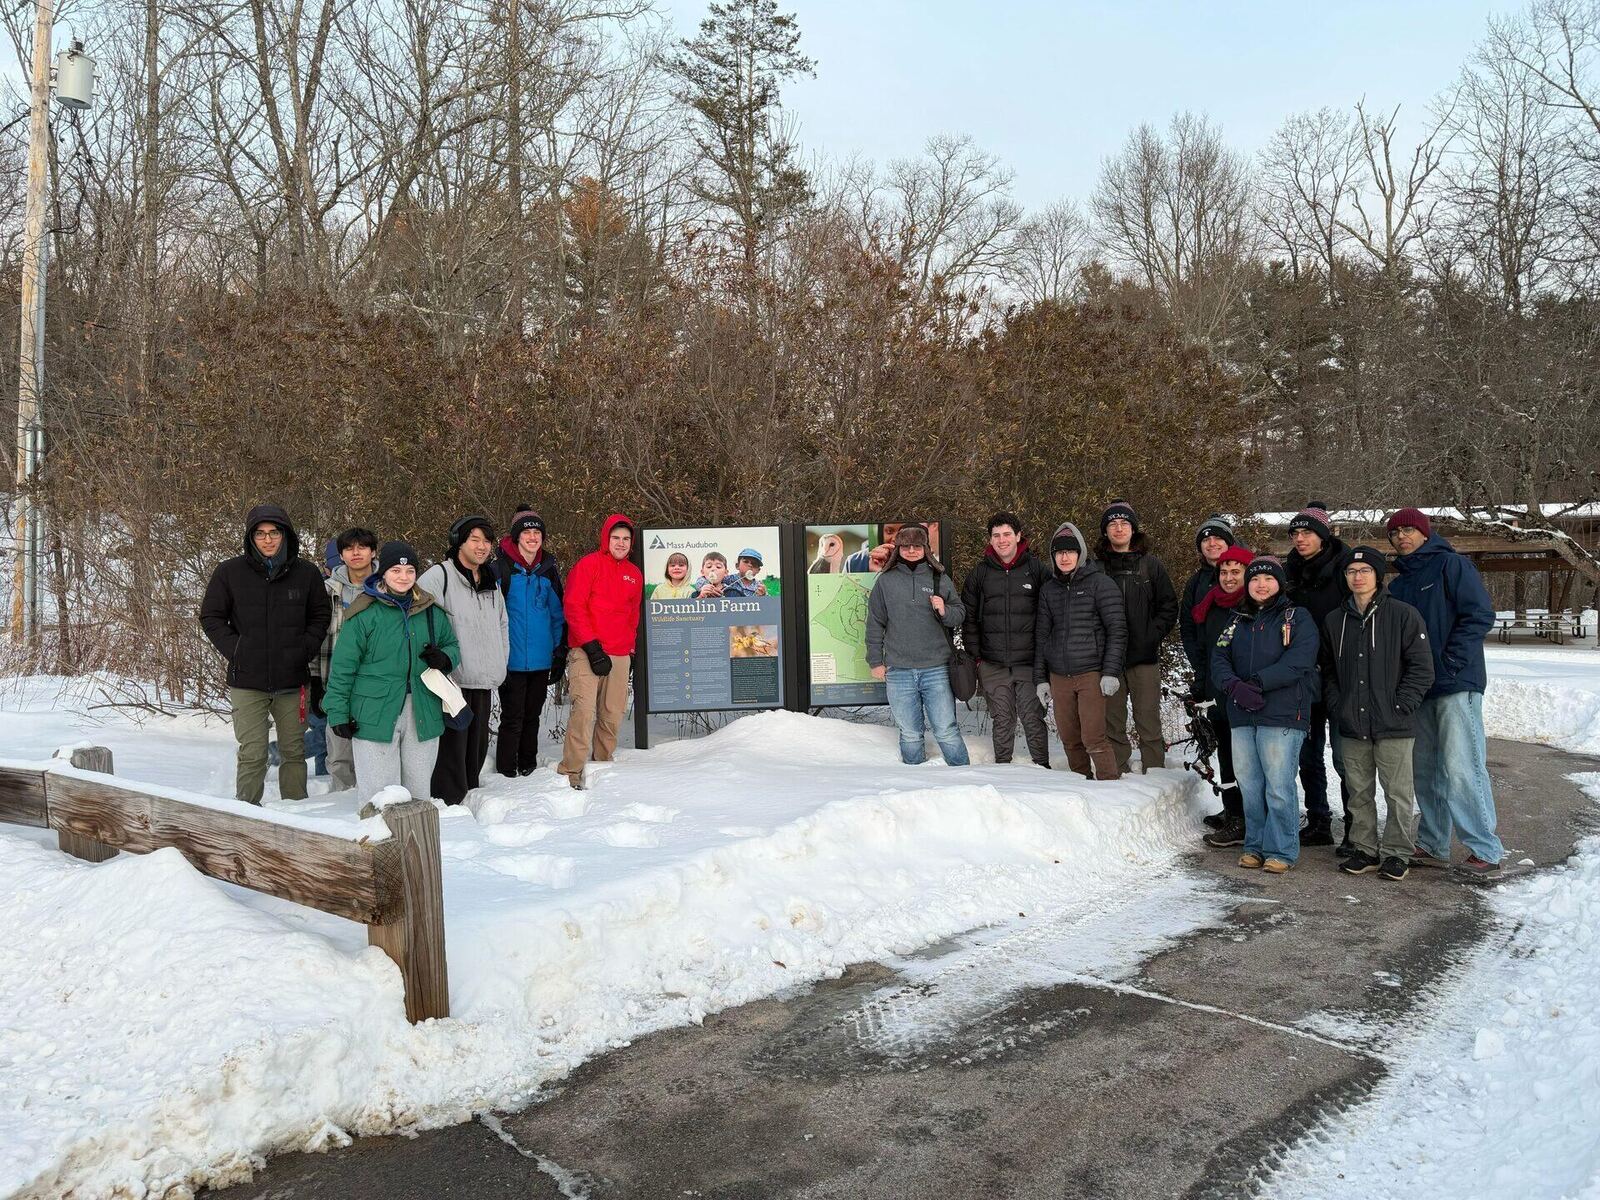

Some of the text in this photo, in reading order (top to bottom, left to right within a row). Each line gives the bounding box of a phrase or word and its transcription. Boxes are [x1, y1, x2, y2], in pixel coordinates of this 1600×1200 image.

[666, 540, 718, 549] Mass Audubon
[650, 600, 761, 614] Drumlin Farm
